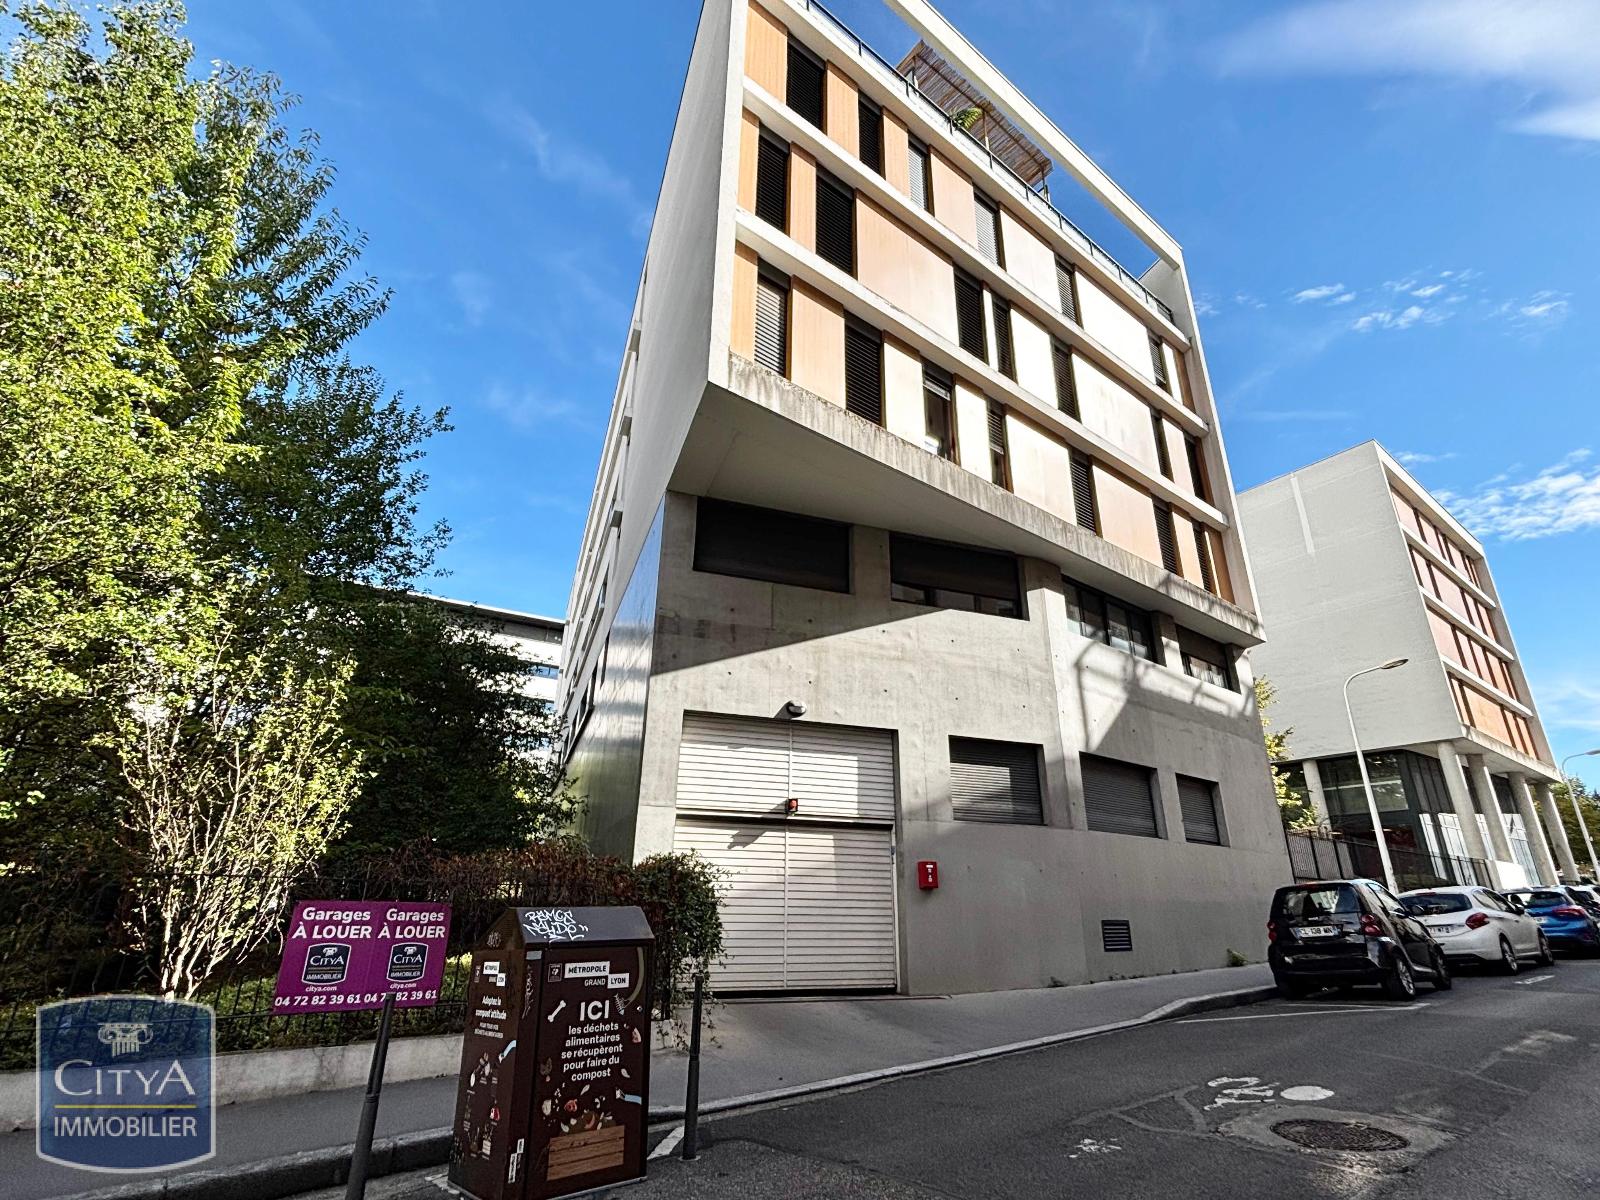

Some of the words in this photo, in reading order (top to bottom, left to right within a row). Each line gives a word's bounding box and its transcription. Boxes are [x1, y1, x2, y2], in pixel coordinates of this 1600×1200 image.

[302, 907, 371, 923] Garages
[386, 908, 444, 923] Garages
[292, 922, 307, 939] À
[312, 925, 372, 939] LOUER
[378, 922, 391, 939] À
[394, 926, 445, 939] LOUER
[390, 970, 421, 978] IMMOBILIER
[568, 964, 607, 975] MÉTROPOLE
[390, 982, 417, 990] citya.com
[584, 978, 606, 987] GRAND
[610, 976, 626, 985] LYON
[305, 985, 337, 993] citya.com
[274, 996, 290, 1007] 04
[294, 995, 308, 1005] 72
[311, 995, 326, 1005] 82
[329, 994, 344, 1004] 39
[347, 993, 361, 1003] 61
[364, 993, 378, 1003] 04
[395, 991, 408, 1001] 82
[410, 990, 423, 1000] 39
[425, 990, 437, 999] 61
[579, 1000, 610, 1021] ICI
[568, 1025, 581, 1034] les
[583, 1022, 619, 1033] déchets
[565, 1033, 621, 1047] alimentaires
[561, 1050, 573, 1059] se
[573, 1044, 623, 1057] récupèrent
[563, 1061, 584, 1072] pour
[586, 1057, 607, 1068] faire
[608, 1055, 620, 1064] du
[571, 1067, 611, 1082] compost
